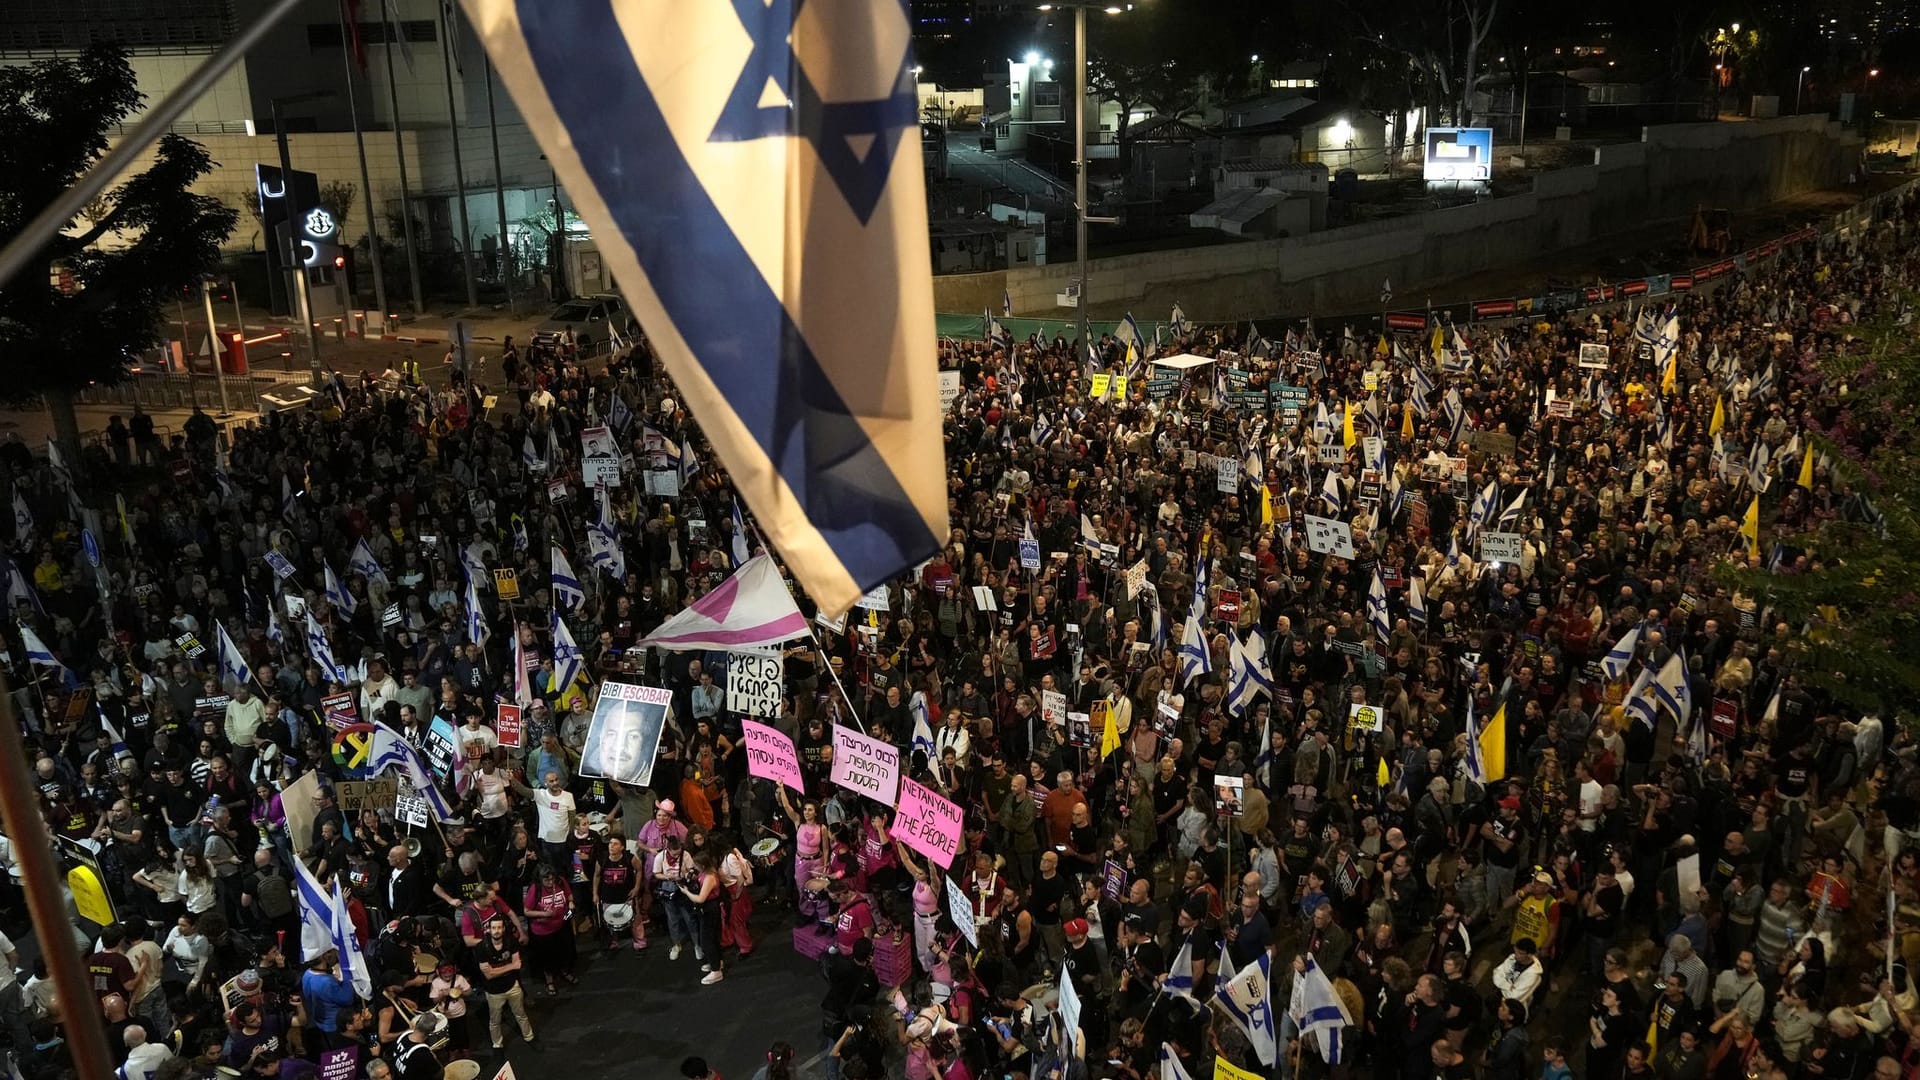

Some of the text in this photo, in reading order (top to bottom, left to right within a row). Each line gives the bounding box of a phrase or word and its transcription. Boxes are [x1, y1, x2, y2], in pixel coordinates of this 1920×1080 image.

[583, 457, 605, 465] בחירות
[1321, 448, 1339, 458] 414
[1219, 459, 1237, 472] 101
[495, 570, 514, 580] 7.10
[727, 652, 780, 681] פושעים
[601, 682, 672, 705] BIBI ESCOBAR
[730, 676, 781, 701] השתלטו
[733, 695, 781, 719] עלינו
[747, 747, 775, 766] עסקה
[902, 779, 962, 824] NETANYAHU
[919, 804, 937, 827] VS.
[897, 811, 957, 857] THE PEOPLE
[331, 1051, 349, 1064] לא
